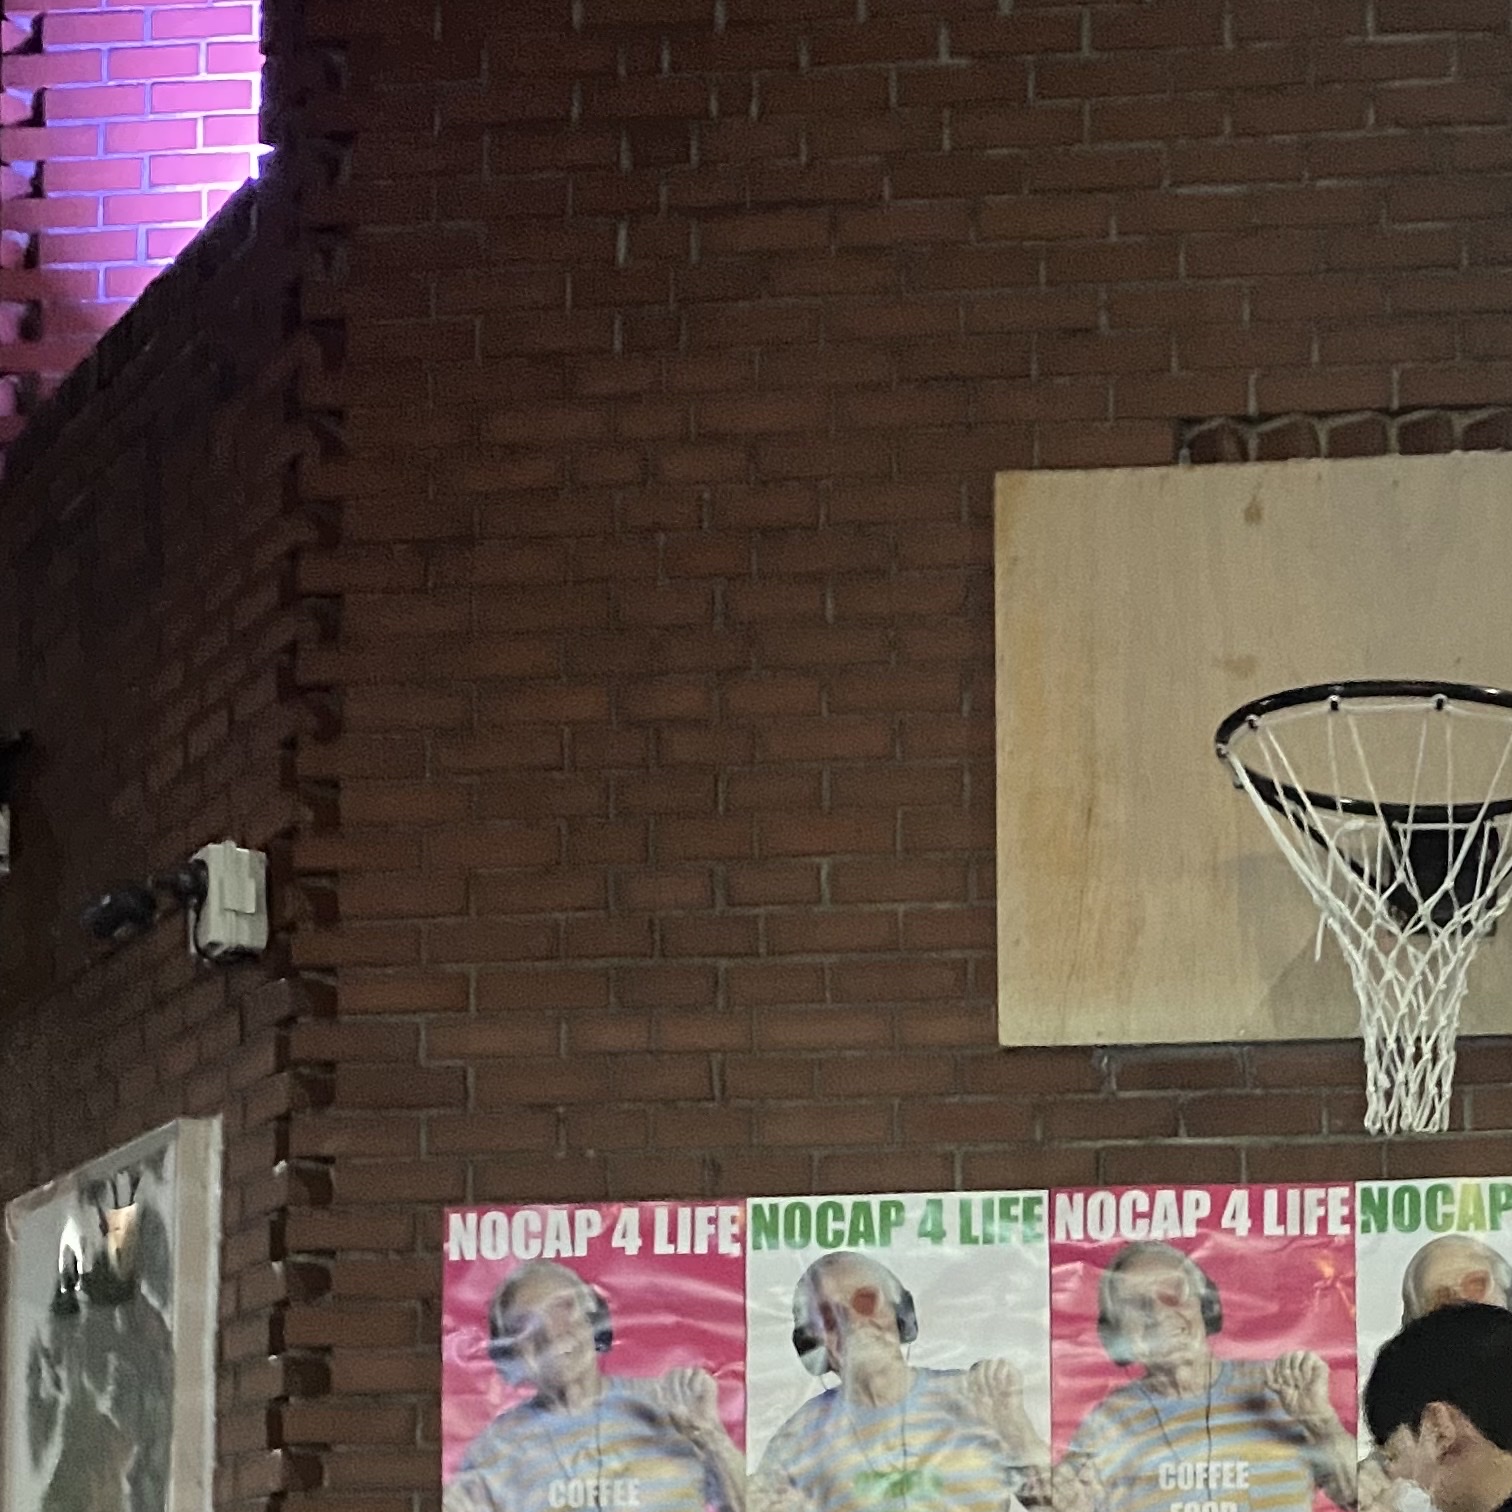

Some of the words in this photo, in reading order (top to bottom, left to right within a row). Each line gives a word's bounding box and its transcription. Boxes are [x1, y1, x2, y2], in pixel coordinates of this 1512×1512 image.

[447, 1208, 604, 1261] NOCAP
[611, 1211, 642, 1257] 4
[655, 1206, 740, 1255] LIFE
[751, 1199, 906, 1250] NOCAP
[918, 1200, 946, 1245] 4
[959, 1196, 1044, 1244] LIFE
[1056, 1190, 1213, 1241] NOCAP
[1221, 1191, 1251, 1236] 4
[1264, 1188, 1350, 1236] LIFE
[549, 1478, 640, 1508] COFFEE
[1159, 1461, 1249, 1490] COFFEE
